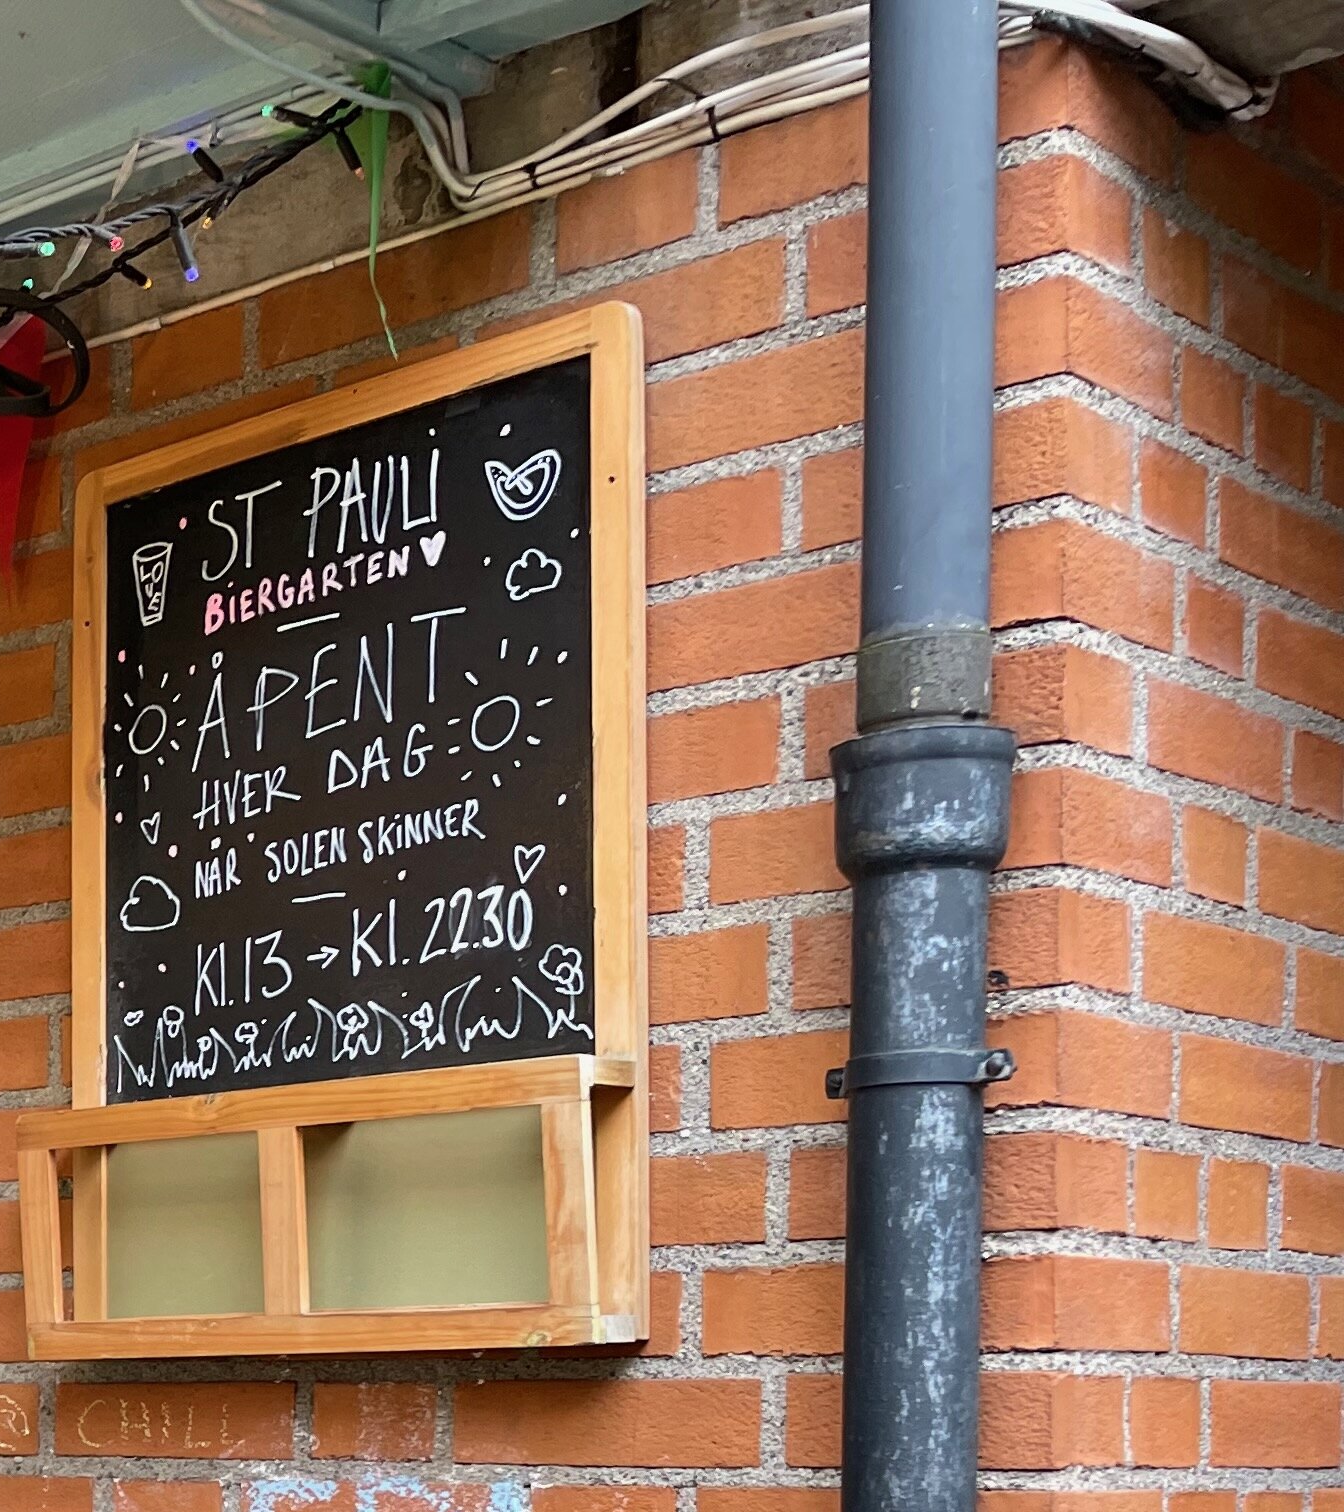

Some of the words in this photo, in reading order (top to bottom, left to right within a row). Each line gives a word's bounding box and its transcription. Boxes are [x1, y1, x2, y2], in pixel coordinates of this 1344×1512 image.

[201, 481, 282, 582] ST
[304, 428, 440, 558] PAULI
[204, 541, 410, 636] BIERGARTEN
[192, 606, 467, 772] ÅPENT
[192, 765, 302, 832] HVER
[326, 724, 434, 795] DAG
[193, 837, 243, 900] NÅR
[264, 827, 348, 883] SOLEN
[357, 799, 487, 865] SKINNER
